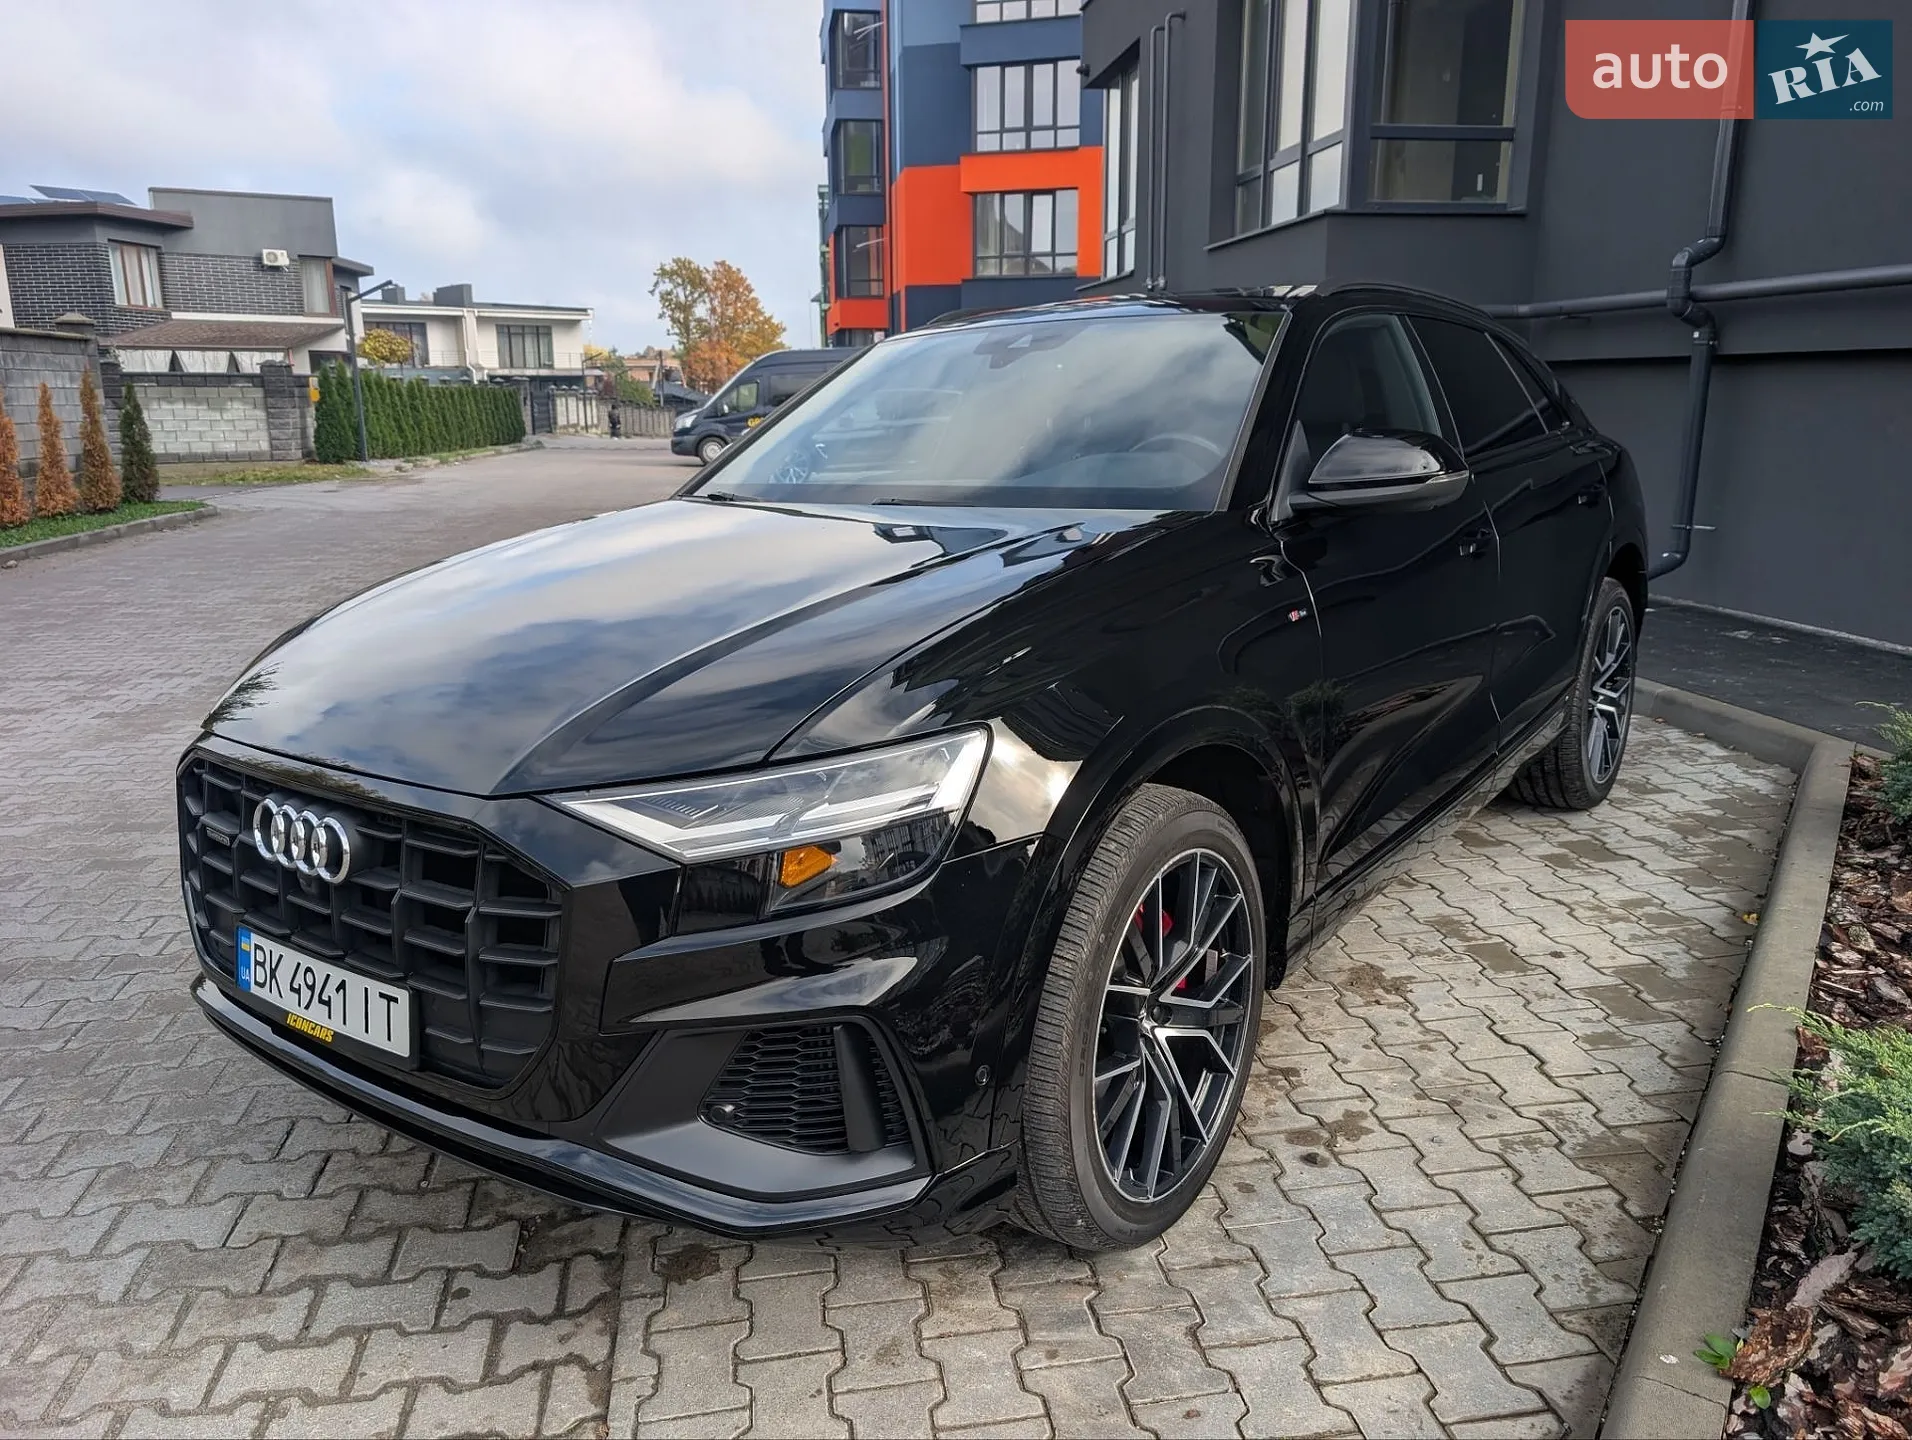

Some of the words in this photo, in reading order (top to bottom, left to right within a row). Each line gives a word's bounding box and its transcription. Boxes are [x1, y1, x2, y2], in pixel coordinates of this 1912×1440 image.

[240, 965, 251, 981] UA
[253, 942, 284, 999] BK
[290, 962, 347, 1026] 4941
[364, 986, 399, 1042] IT
[286, 1012, 335, 1043] ICONCARS
